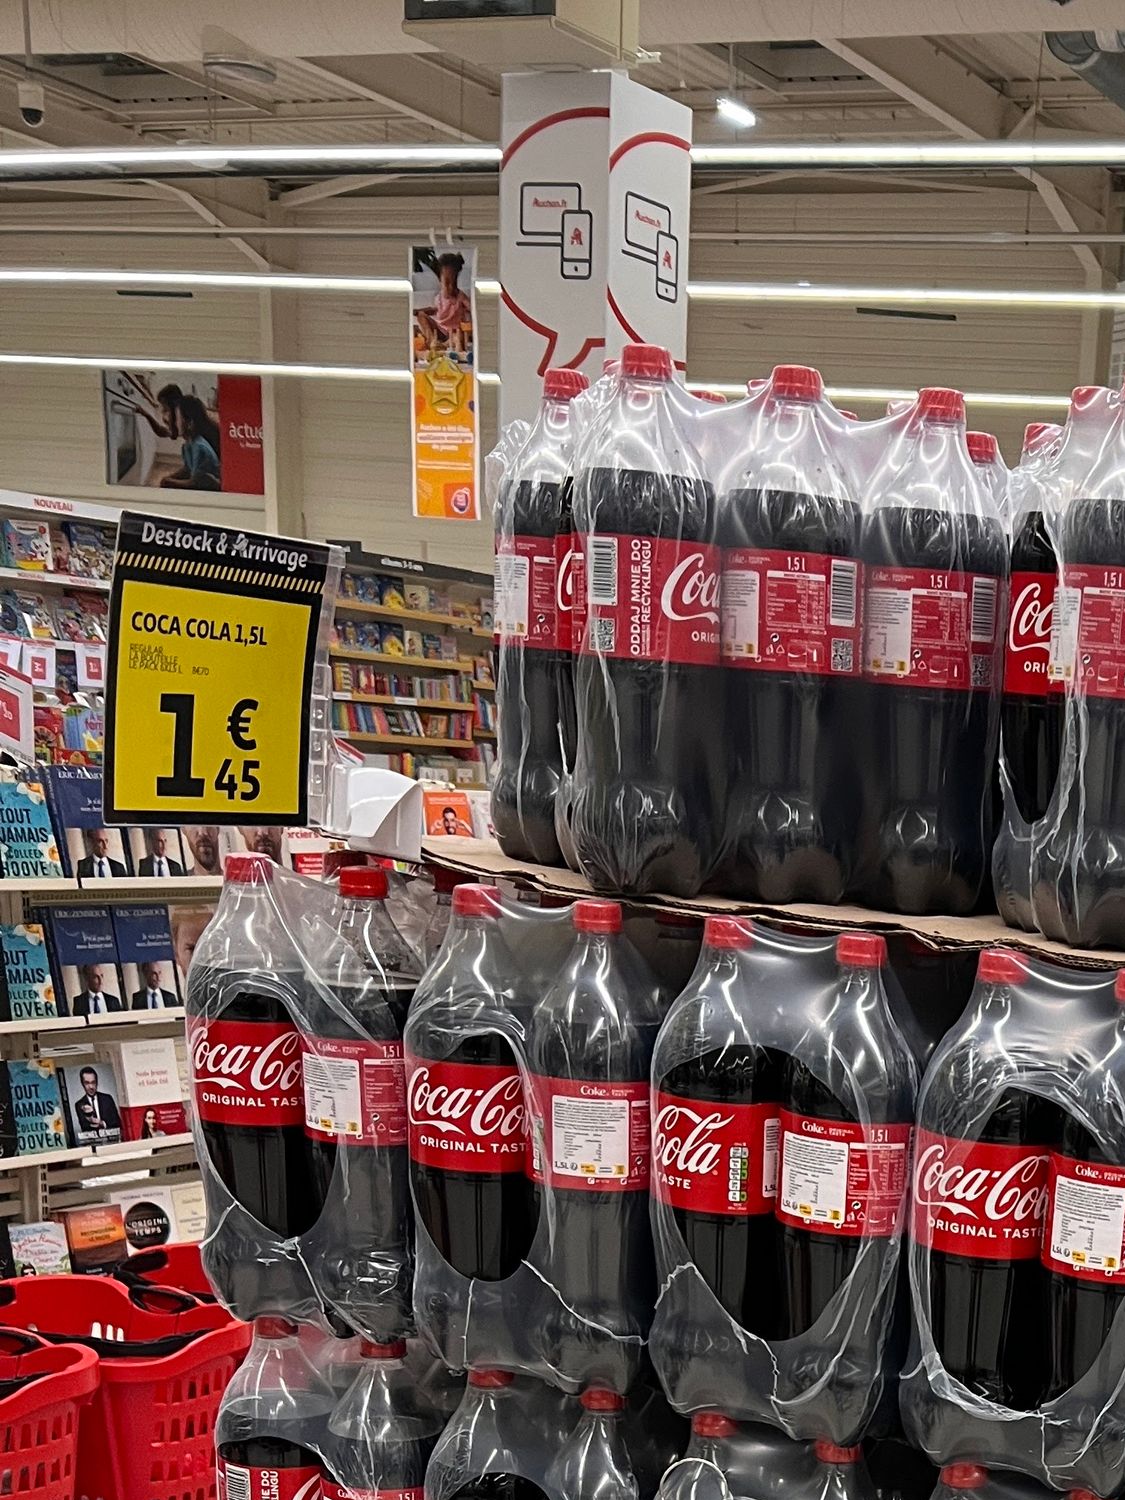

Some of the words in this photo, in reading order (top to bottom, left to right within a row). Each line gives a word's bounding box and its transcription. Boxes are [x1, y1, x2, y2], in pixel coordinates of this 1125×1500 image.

[34, 498, 73, 512] NOUVEAU
[141, 522, 212, 551] Destock
[216, 533, 228, 555] &
[231, 533, 308, 572] Arrivage
[631, 539, 641, 563] DO
[631, 563, 641, 598] MNIE
[641, 540, 651, 624] RECYKLINGU
[131, 611, 181, 636] COCA
[186, 618, 231, 642] COLA
[235, 624, 267, 647] 1,5L
[631, 599, 641, 656] ODDAJ
[156, 693, 205, 799] 1
[226, 698, 259, 751] €
[214, 758, 261, 801] 45
[4, 950, 28, 965] OUT
[14, 1002, 55, 1017] OVER
[581, 1085, 607, 1096] Coke
[15, 1100, 55, 1118] AMAIS
[202, 1093, 266, 1107] ORIGINAL
[274, 1097, 302, 1106] TAS
[802, 1120, 825, 1134] Coke
[420, 1135, 485, 1153] ORIGINAL
[490, 1143, 526, 1153] TAST
[658, 1171, 691, 1189] TASTE
[1076, 1164, 1099, 1179] Coke
[927, 1217, 997, 1238] ORIGINAL
[261, 1471, 269, 1486] DO
